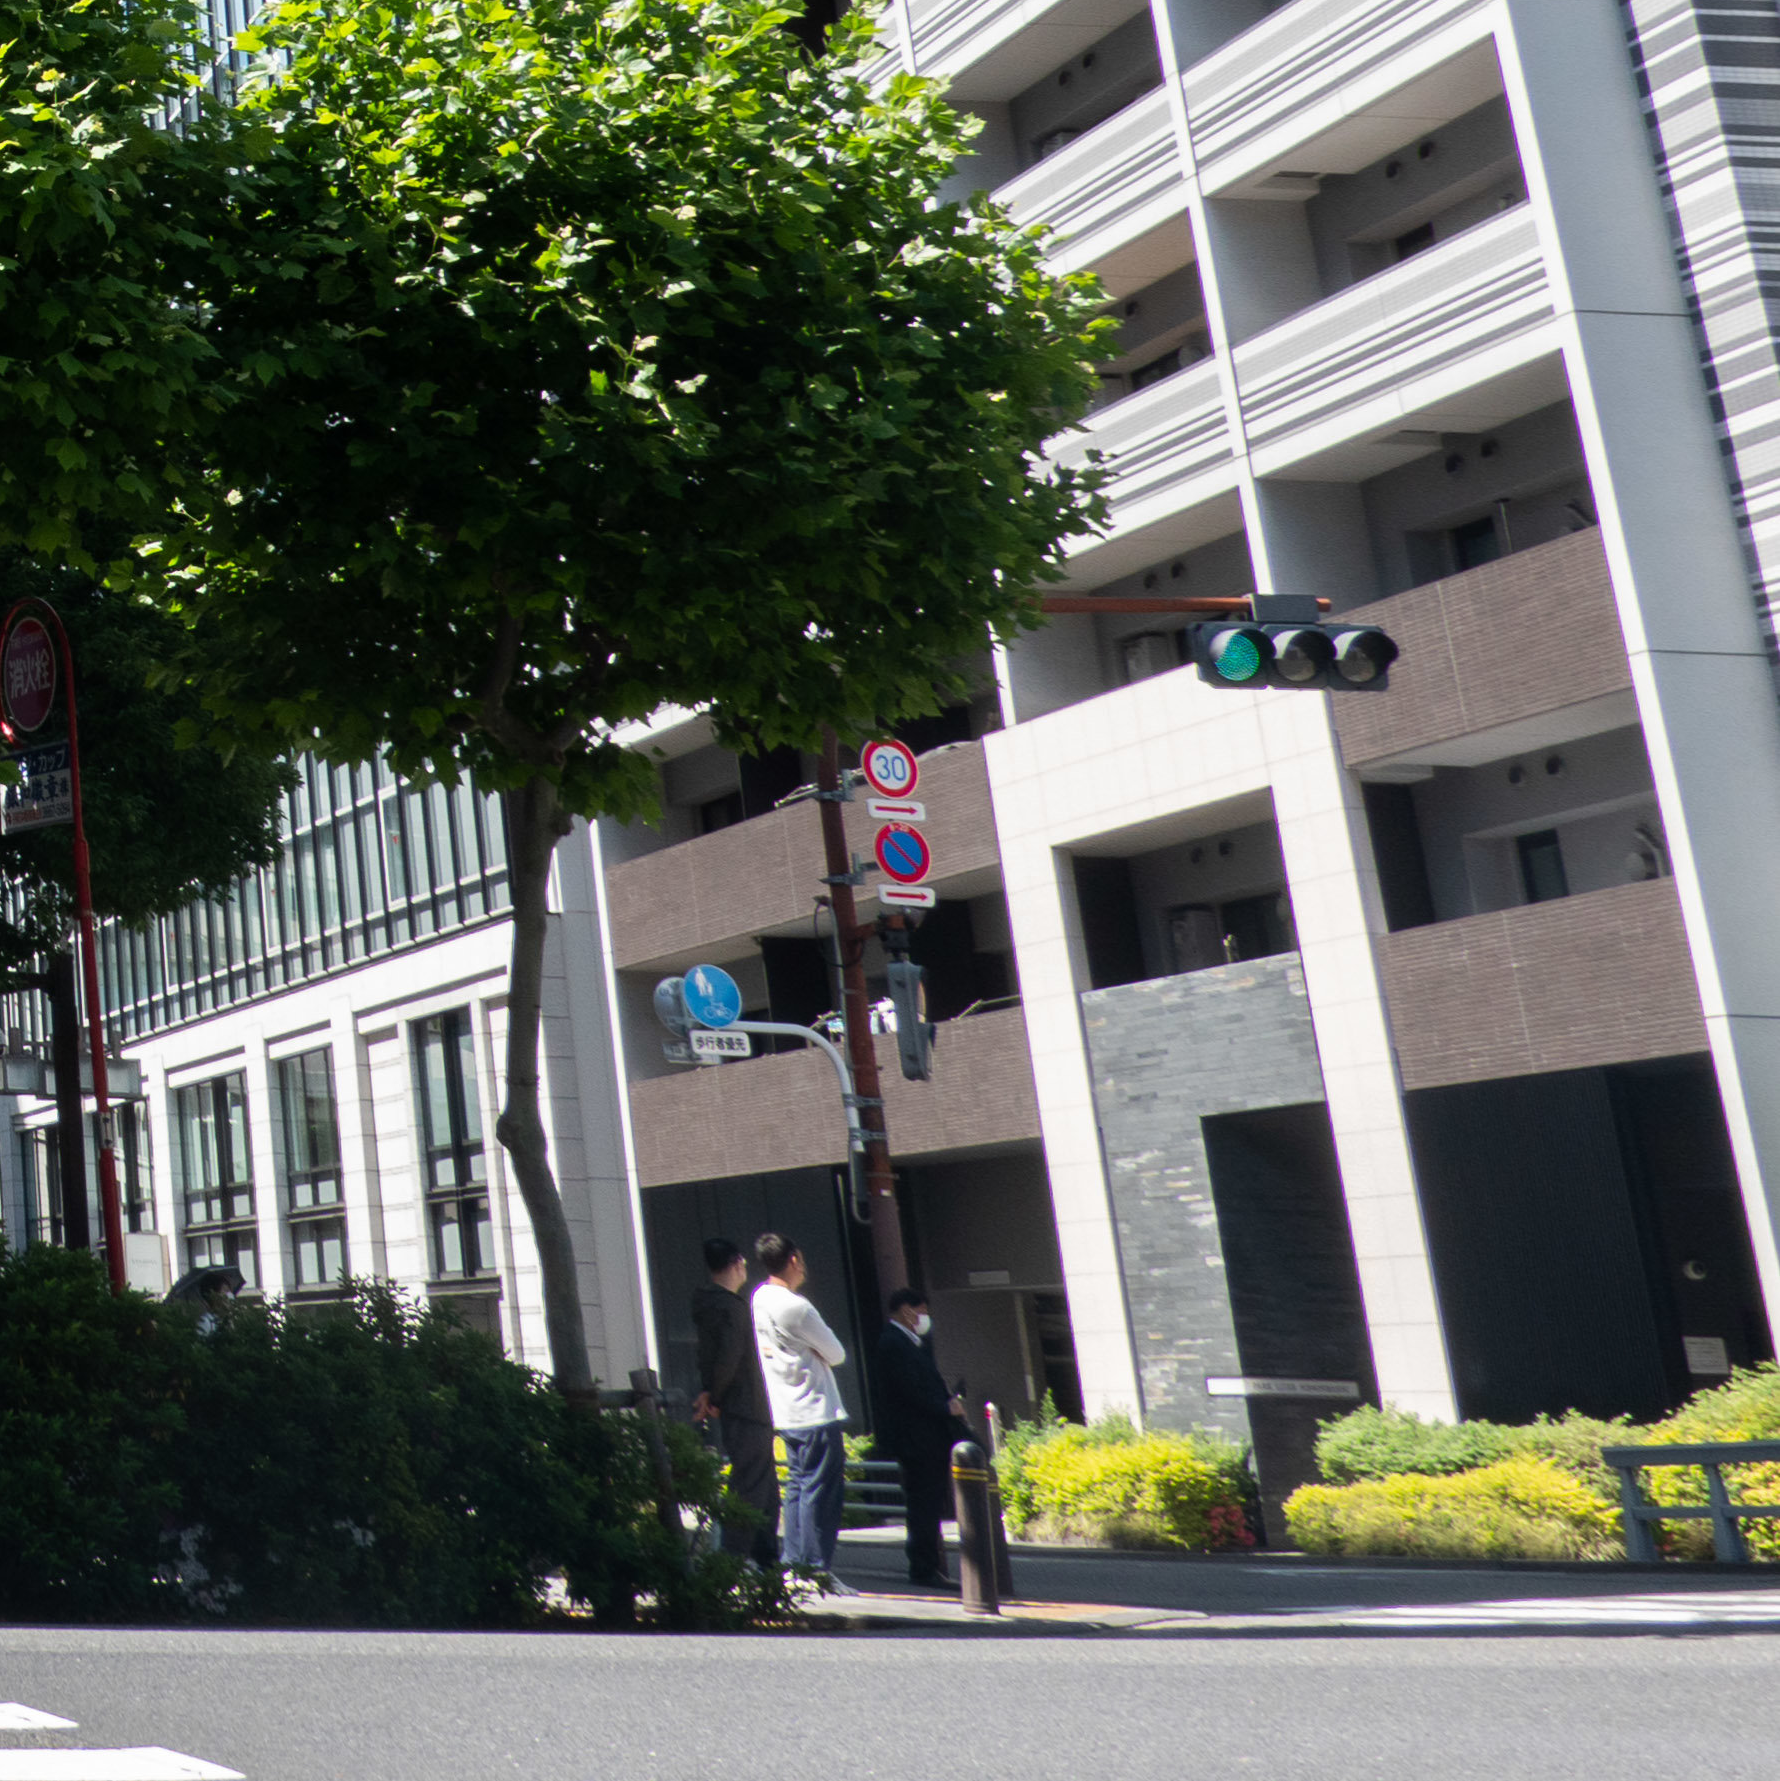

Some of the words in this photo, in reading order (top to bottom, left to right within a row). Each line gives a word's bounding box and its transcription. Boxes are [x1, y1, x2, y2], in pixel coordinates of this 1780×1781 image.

[8, 648, 51, 700] 消火栓
[875, 754, 907, 782] 30
